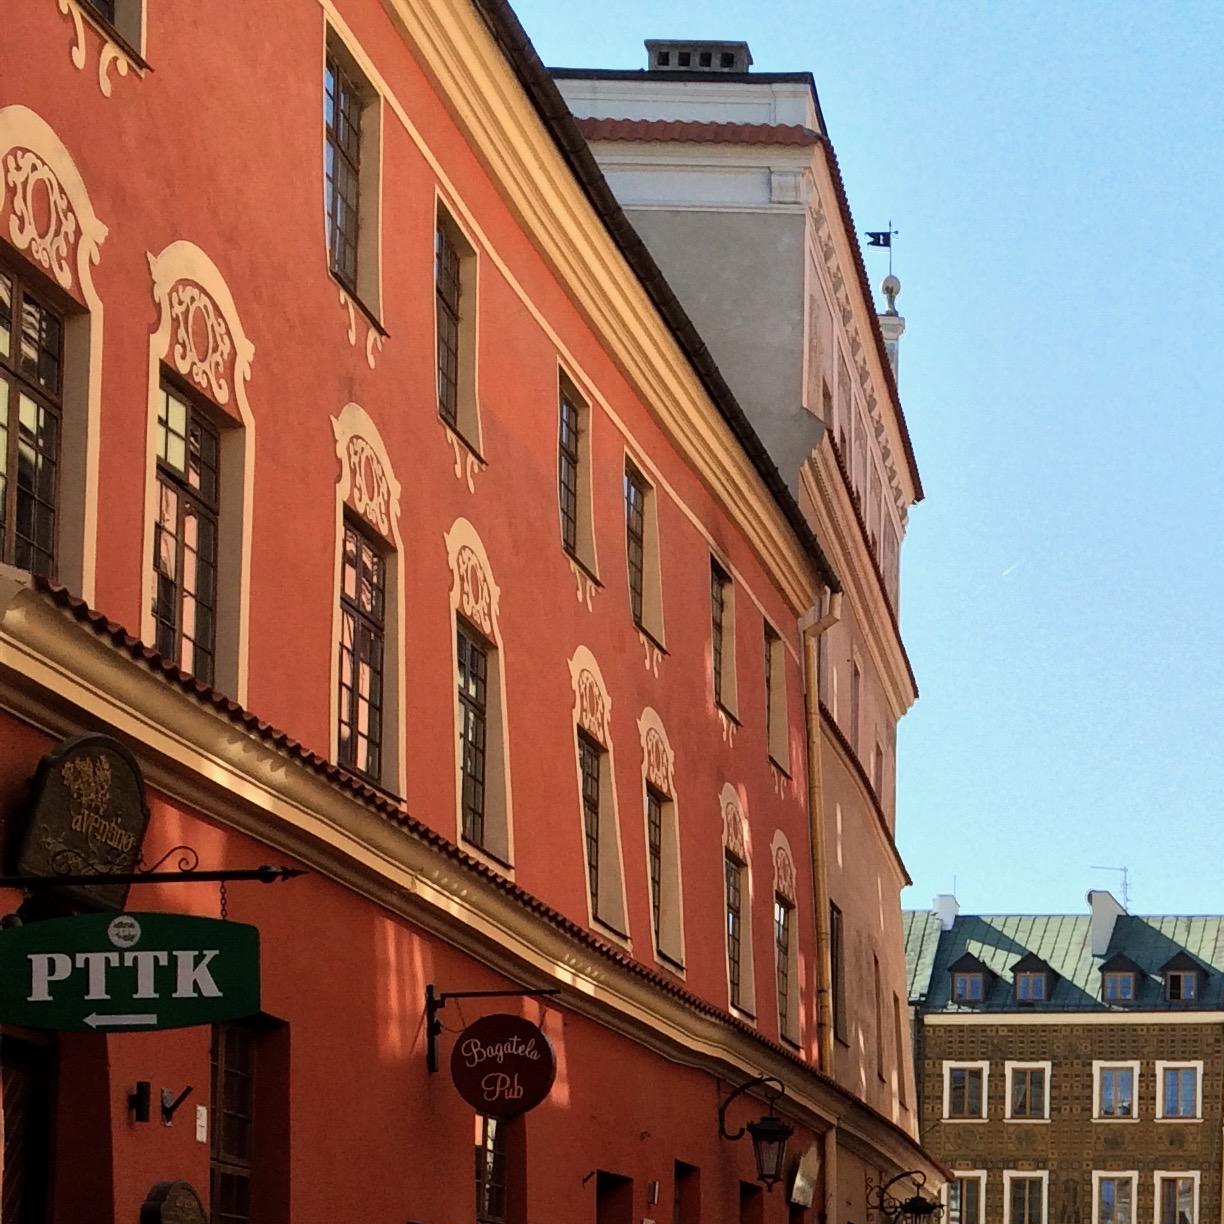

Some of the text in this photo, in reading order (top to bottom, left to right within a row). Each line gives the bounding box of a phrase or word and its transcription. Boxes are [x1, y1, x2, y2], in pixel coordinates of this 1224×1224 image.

[26, 949, 224, 1002] PTTK
[461, 1034, 541, 1068] Bagatela
[481, 1072, 524, 1102] Pub
